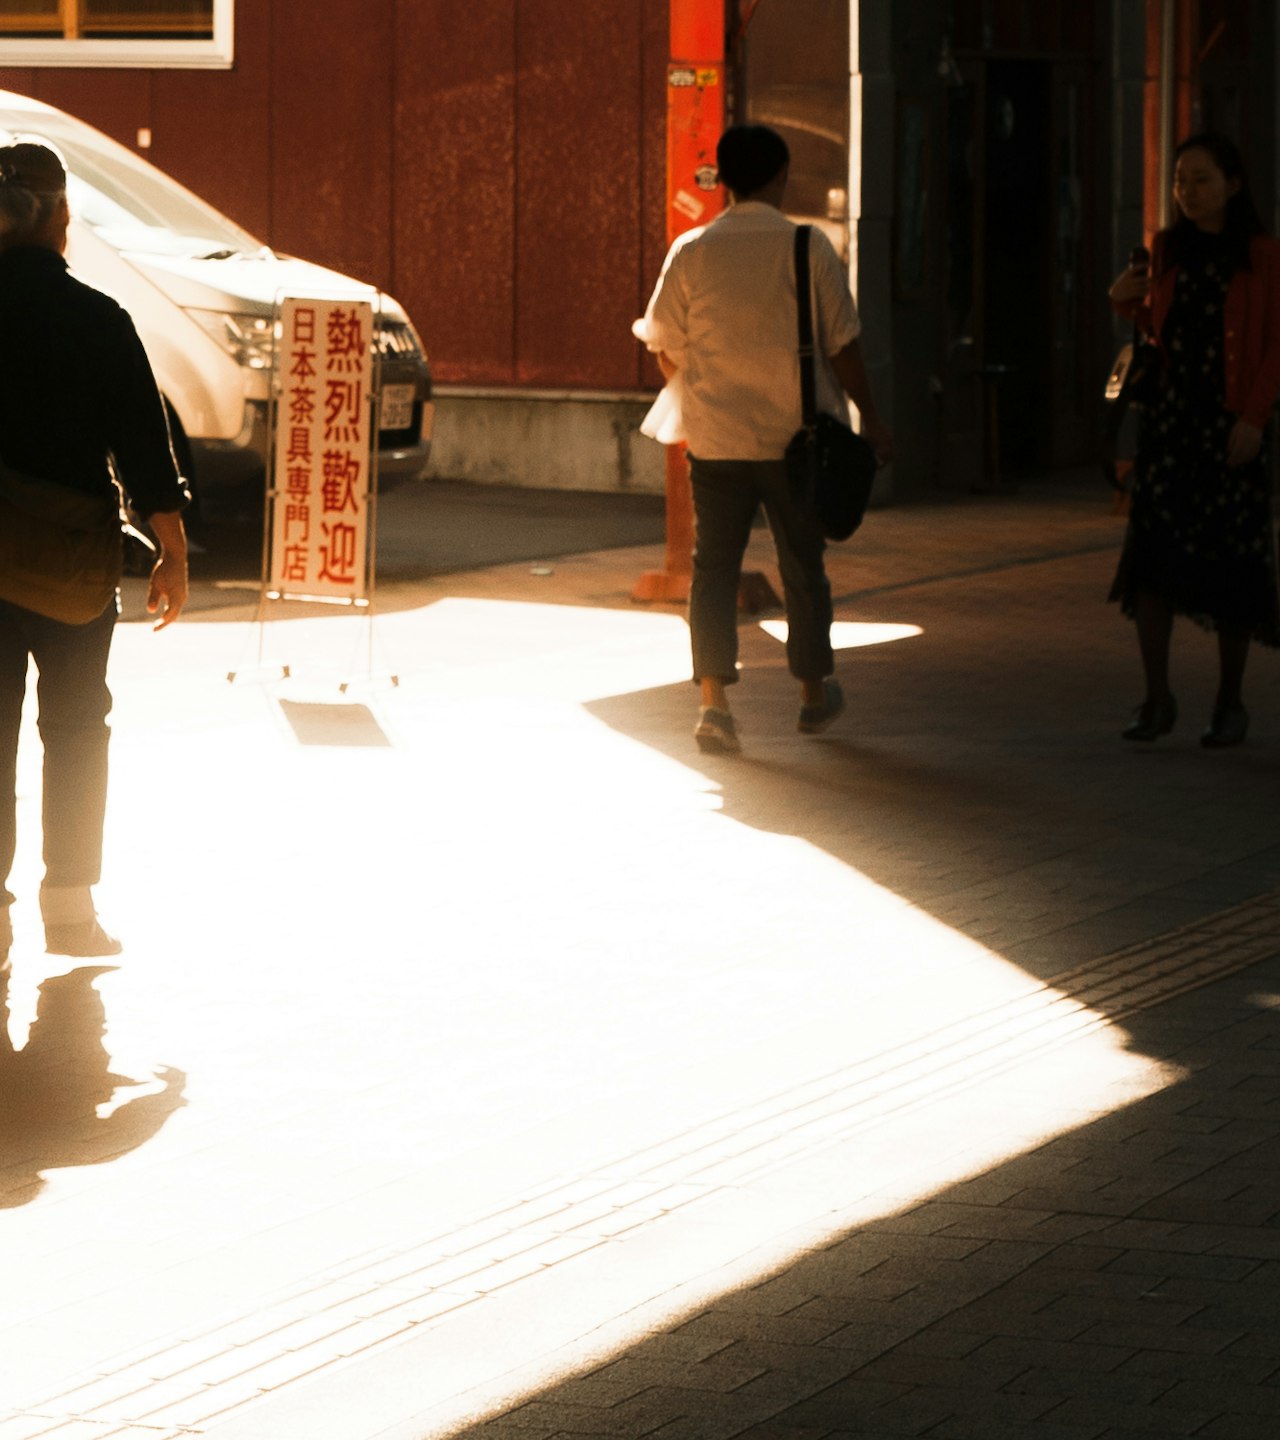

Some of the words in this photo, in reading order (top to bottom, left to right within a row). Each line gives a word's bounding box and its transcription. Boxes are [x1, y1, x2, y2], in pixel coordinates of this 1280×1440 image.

[280, 307, 317, 583] 日本茶具専門店
